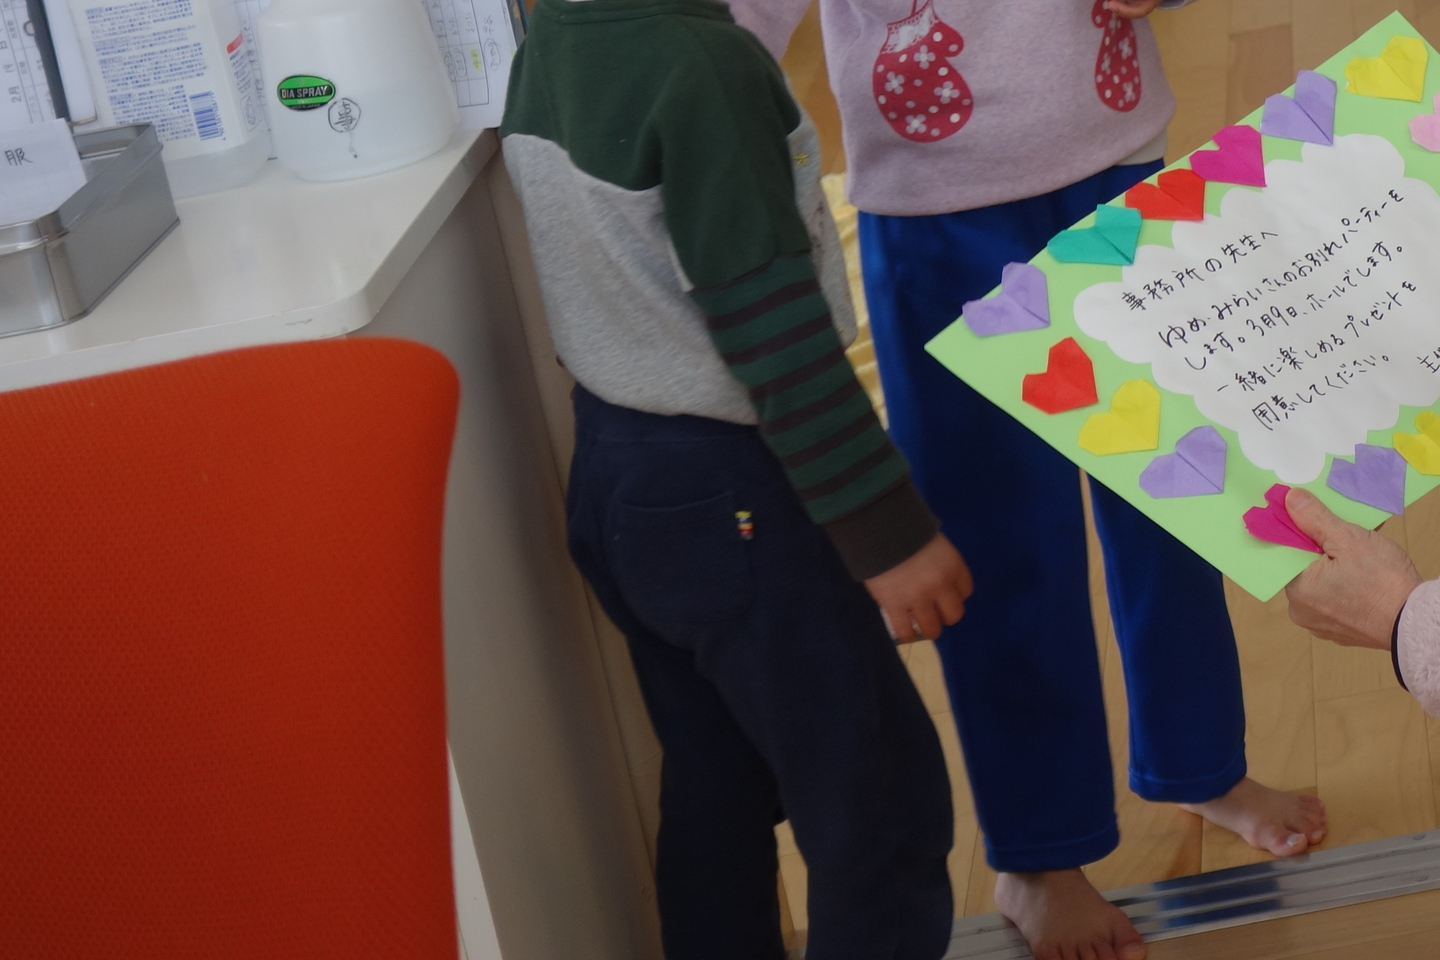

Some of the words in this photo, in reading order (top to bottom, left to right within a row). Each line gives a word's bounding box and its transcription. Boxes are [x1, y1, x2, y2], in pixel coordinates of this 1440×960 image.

[281, 88, 295, 99] DIA
[296, 85, 328, 98] SPRAY
[1121, 231, 1279, 311] 事務所の先生へ
[1217, 281, 1416, 392] 一緒に楽しめるプレゼントを
[1252, 355, 1390, 431] 用意してください。
